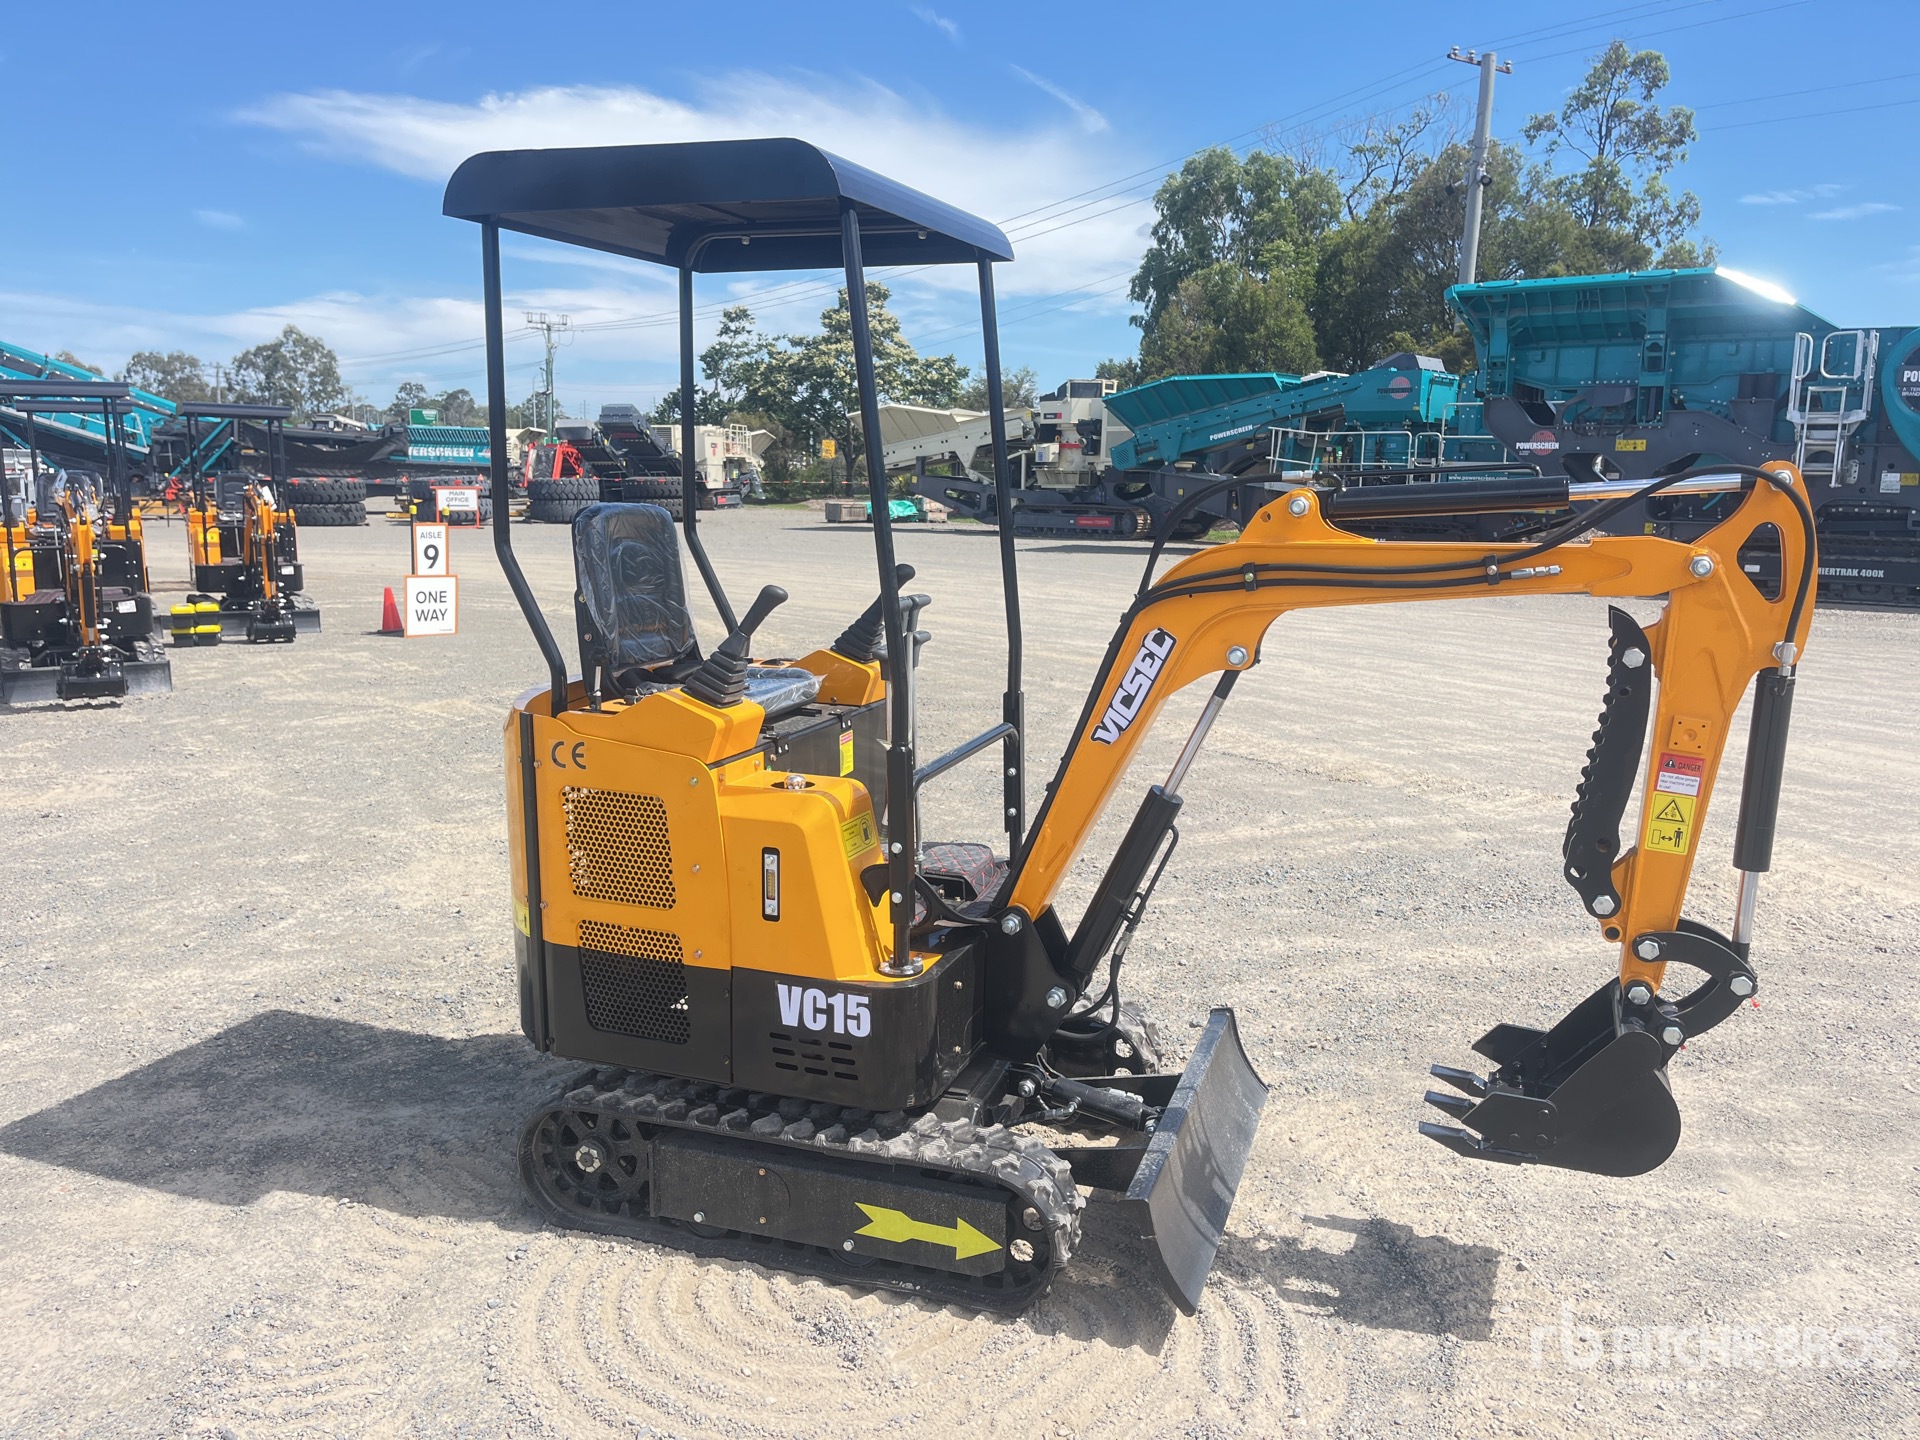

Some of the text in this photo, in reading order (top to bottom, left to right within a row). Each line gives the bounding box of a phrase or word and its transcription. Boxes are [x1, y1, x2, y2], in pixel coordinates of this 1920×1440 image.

[1903, 370, 1920, 382] PO
[1209, 424, 1253, 441] POWERSCREEN
[1516, 442, 1560, 450] POWERSCREEN
[420, 531, 443, 539] AISLE
[423, 544, 440, 569] 9
[1860, 569, 1885, 578] 400X
[415, 590, 448, 604] ONE
[415, 608, 448, 622] WAY
[1678, 762, 1701, 771] DANGER
[777, 983, 871, 1038] VC15
